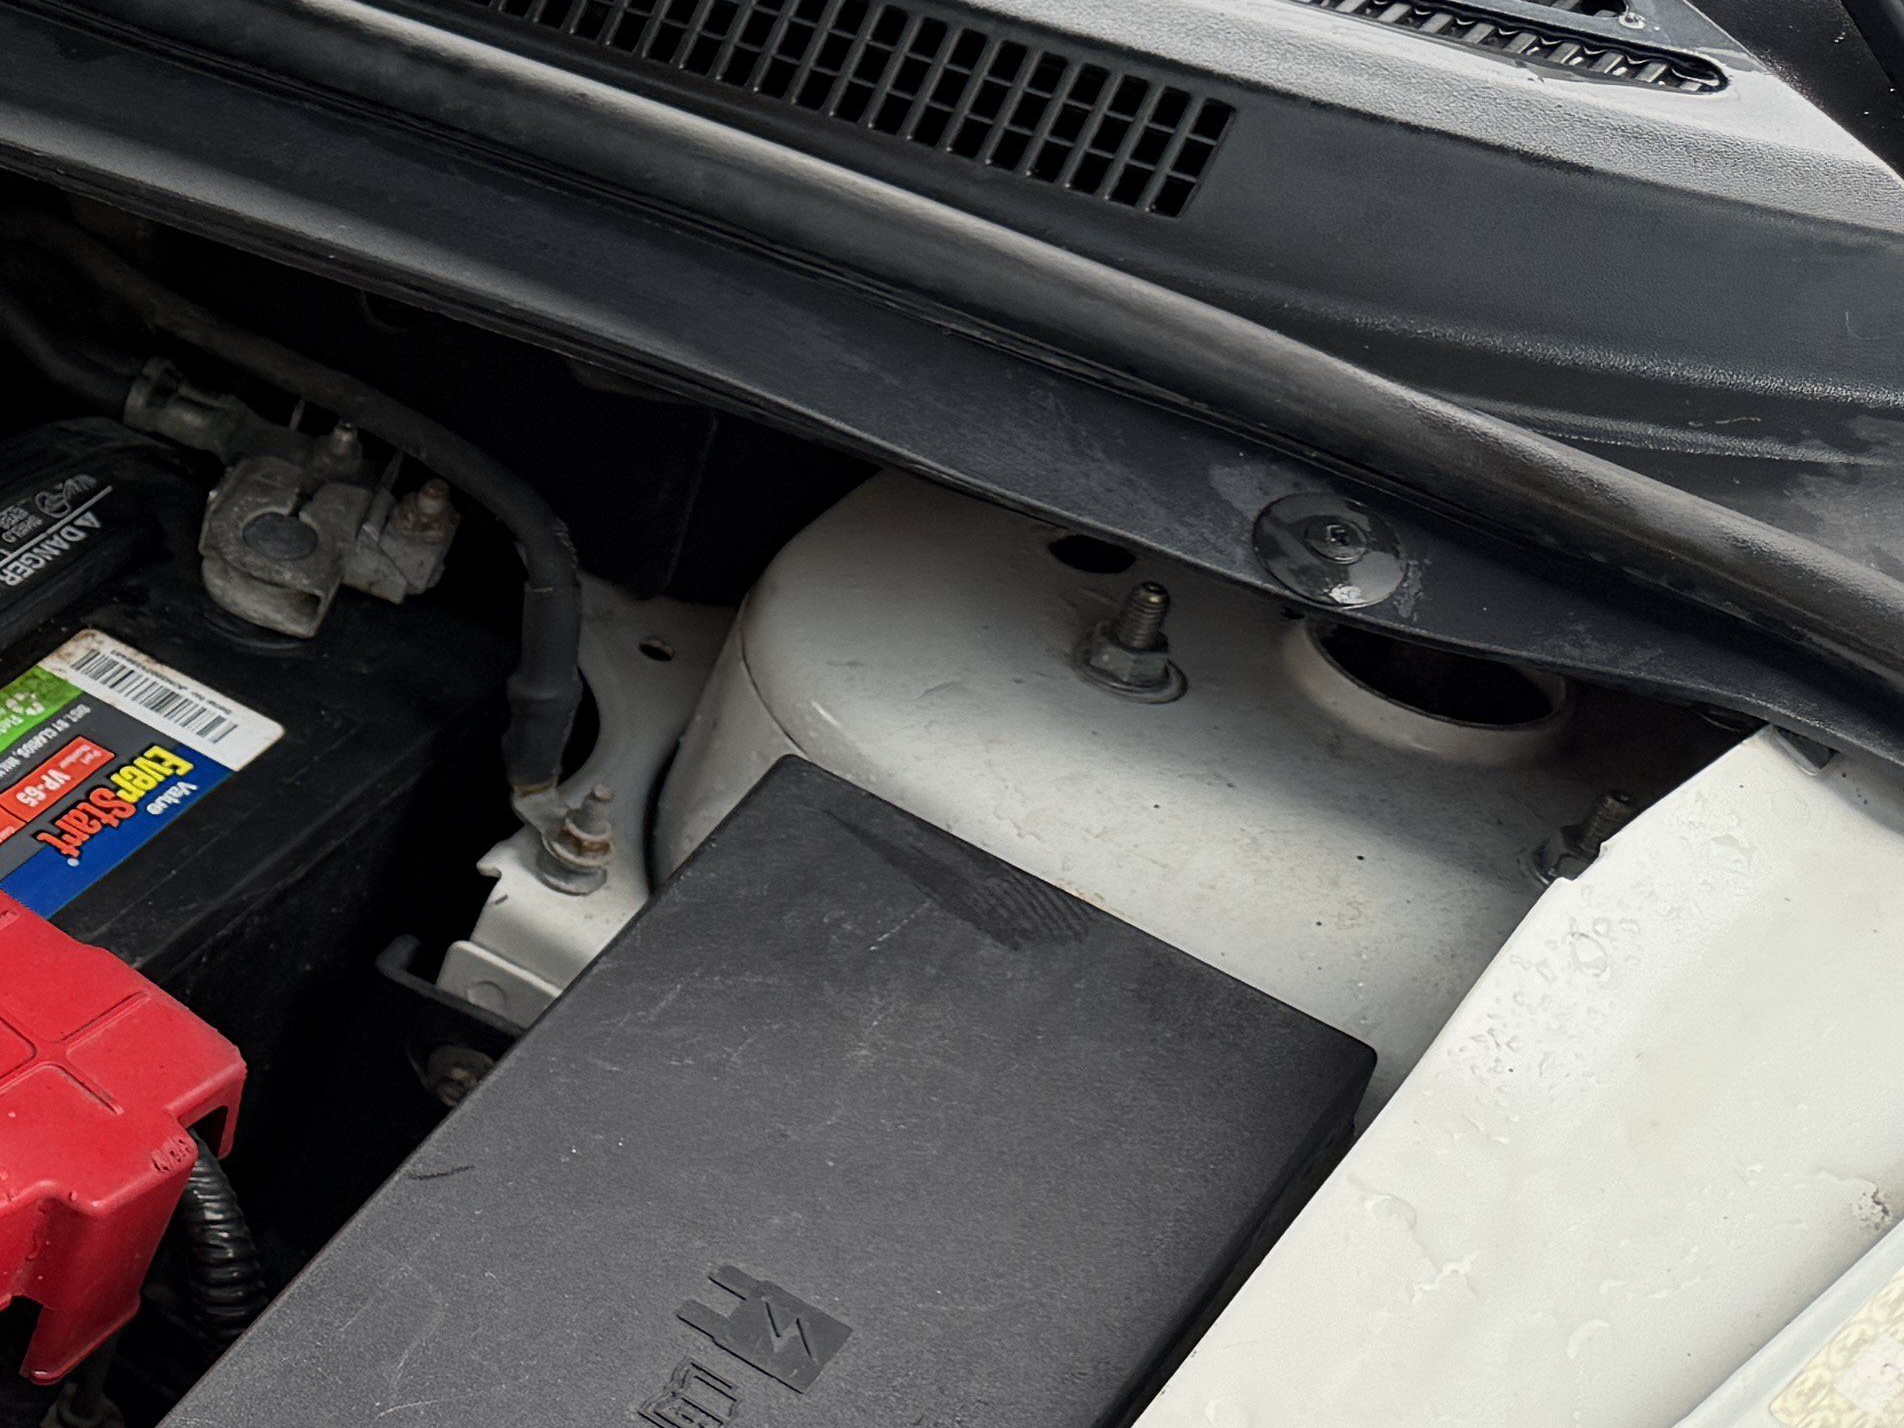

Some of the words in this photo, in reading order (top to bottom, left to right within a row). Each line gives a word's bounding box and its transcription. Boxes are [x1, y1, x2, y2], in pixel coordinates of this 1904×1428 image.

[16, 763, 70, 806] VP-65
[37, 745, 194, 858] EverStart
[146, 781, 198, 815] Value
